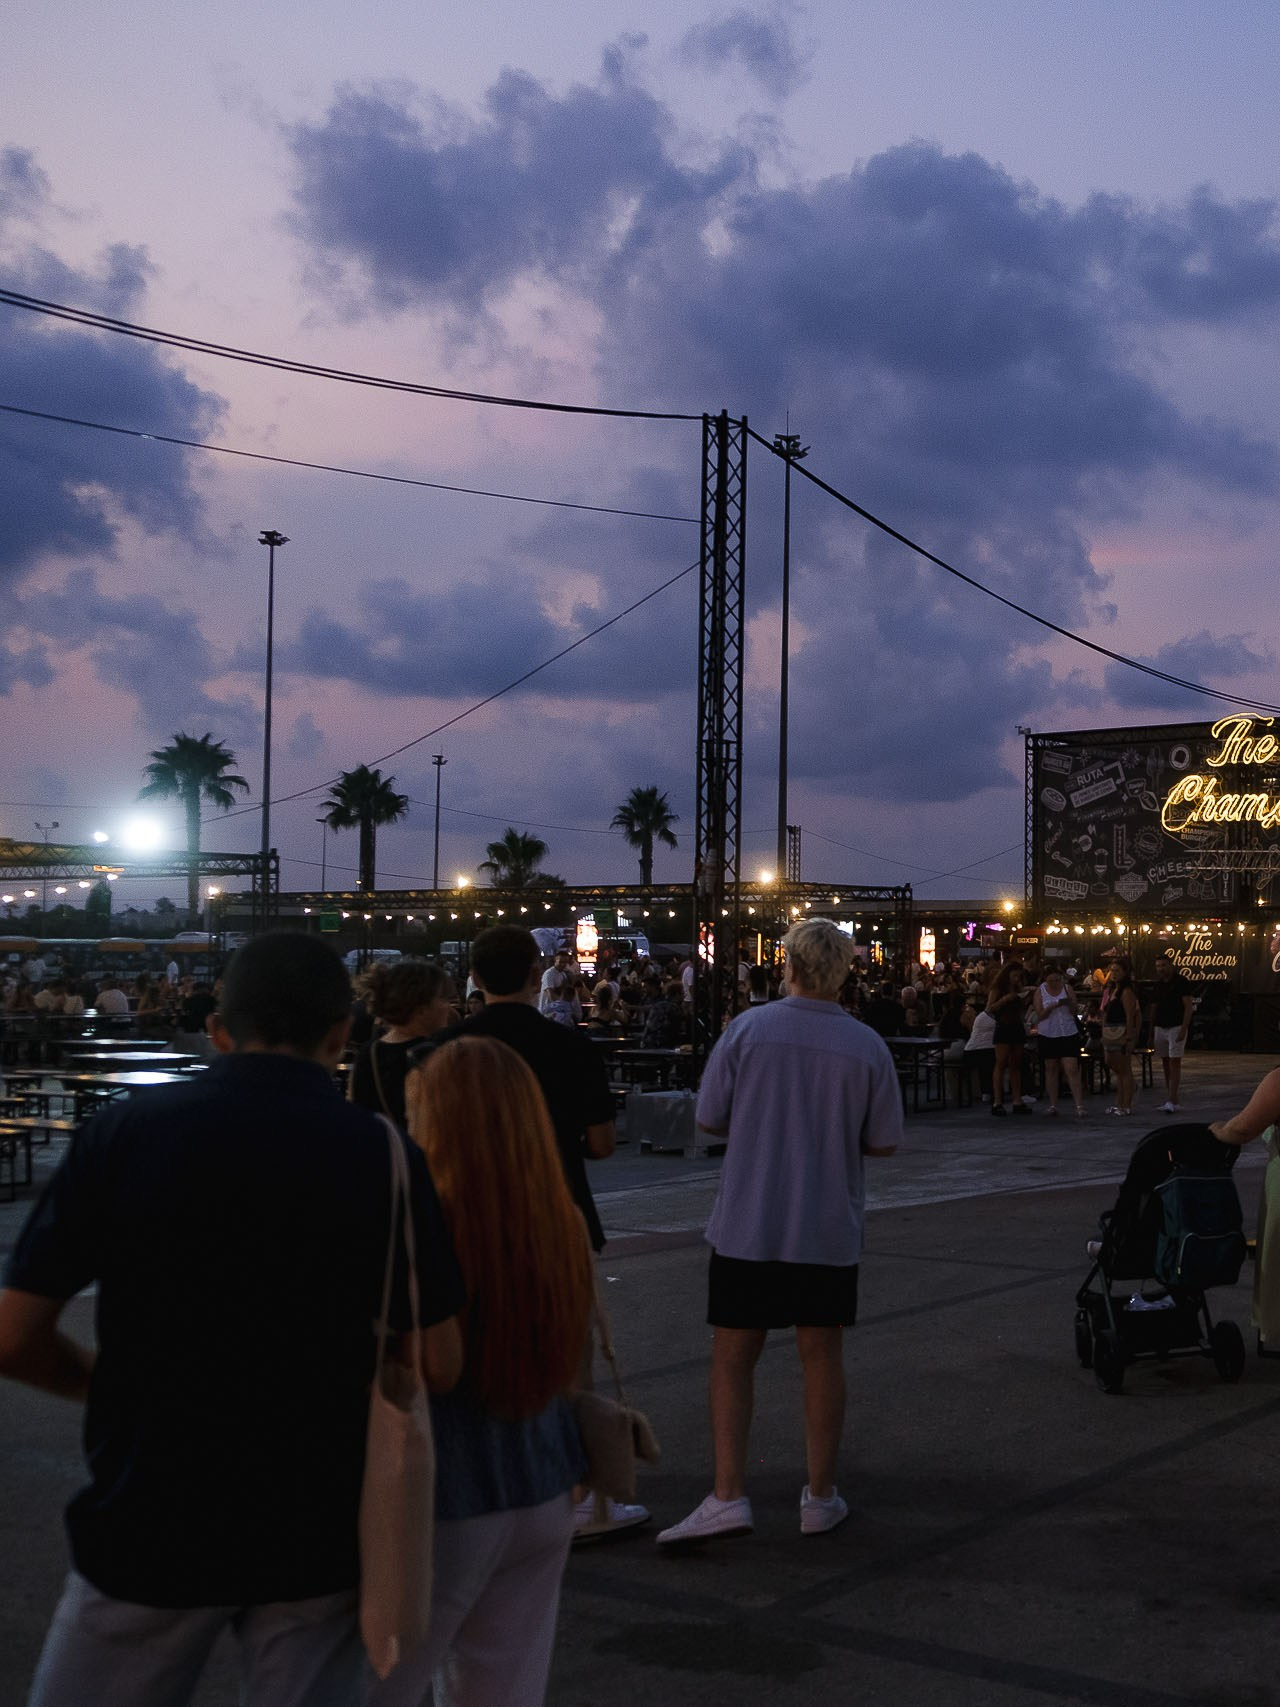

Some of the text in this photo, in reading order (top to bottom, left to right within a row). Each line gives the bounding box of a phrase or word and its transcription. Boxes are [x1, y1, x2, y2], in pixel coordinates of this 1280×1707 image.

[1206, 713, 1279, 767] The
[1076, 768, 1104, 787] RUTA
[1184, 932, 1213, 955] The
[1164, 948, 1239, 968] Champions
